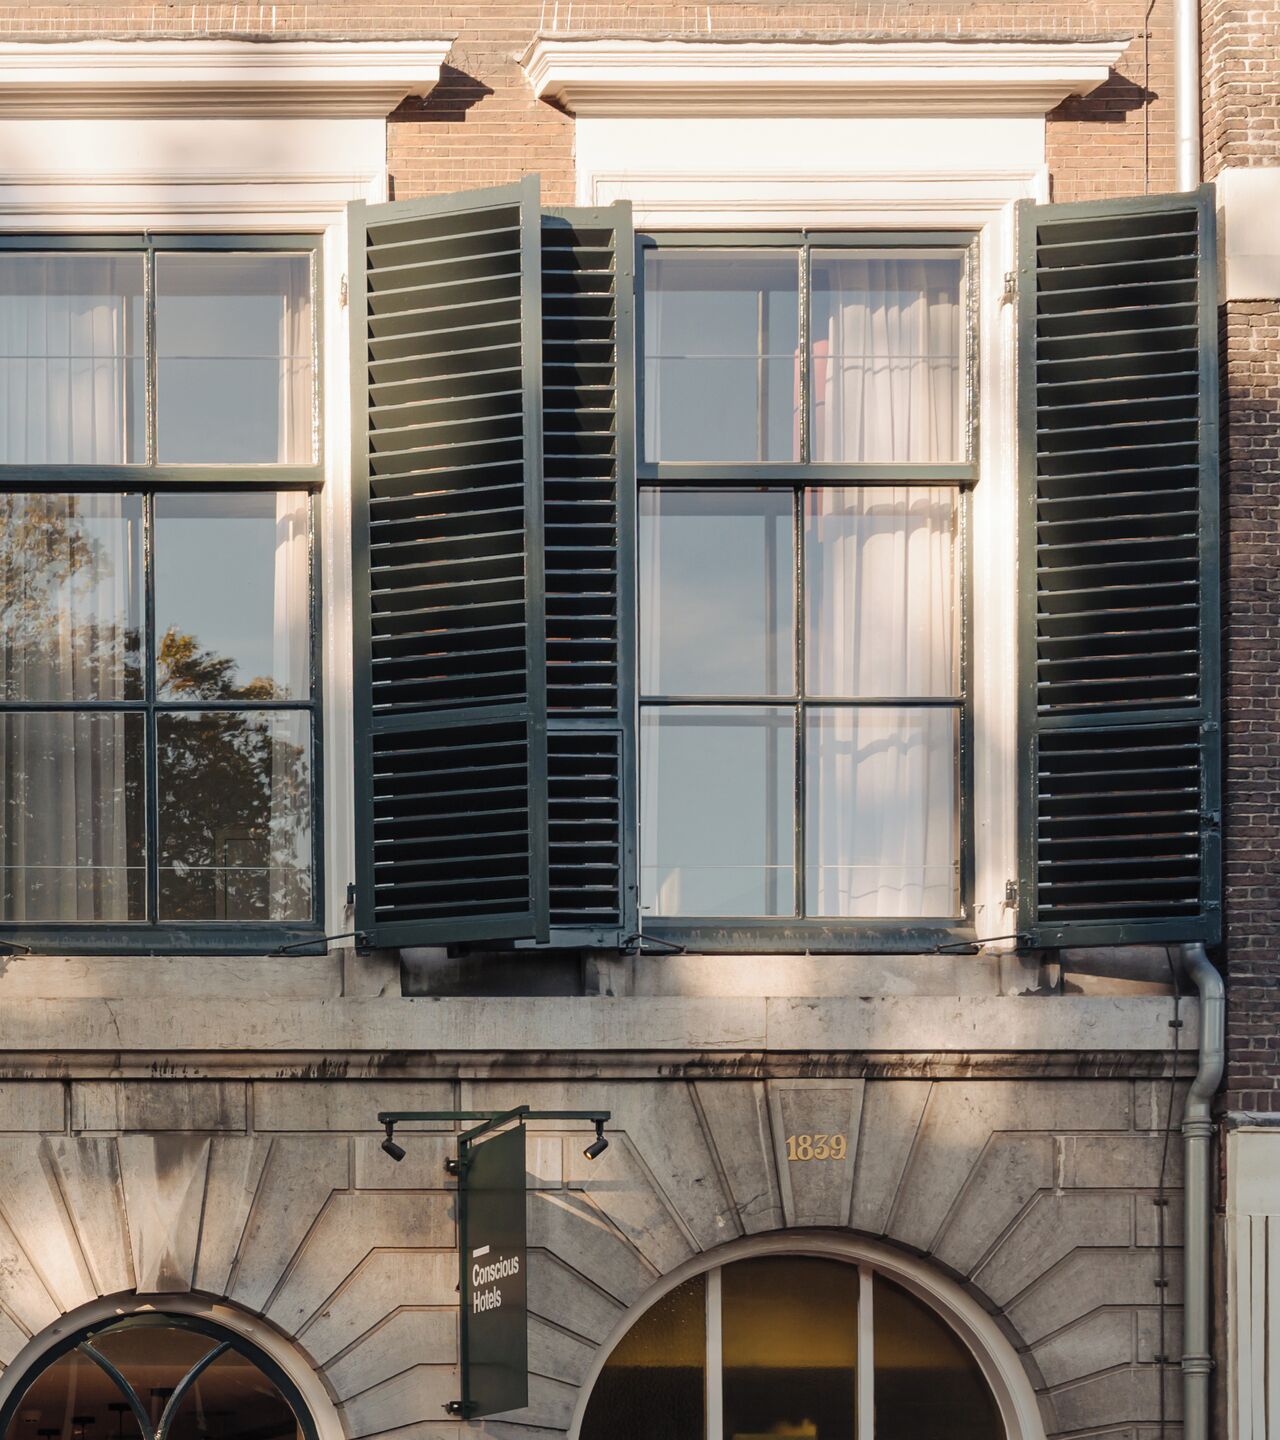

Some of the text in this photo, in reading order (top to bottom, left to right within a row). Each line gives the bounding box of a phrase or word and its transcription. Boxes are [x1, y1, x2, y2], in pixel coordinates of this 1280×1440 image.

[785, 1134, 846, 1160] 1839
[472, 1256, 519, 1287] Conscious
[473, 1287, 501, 1314] Hotels
